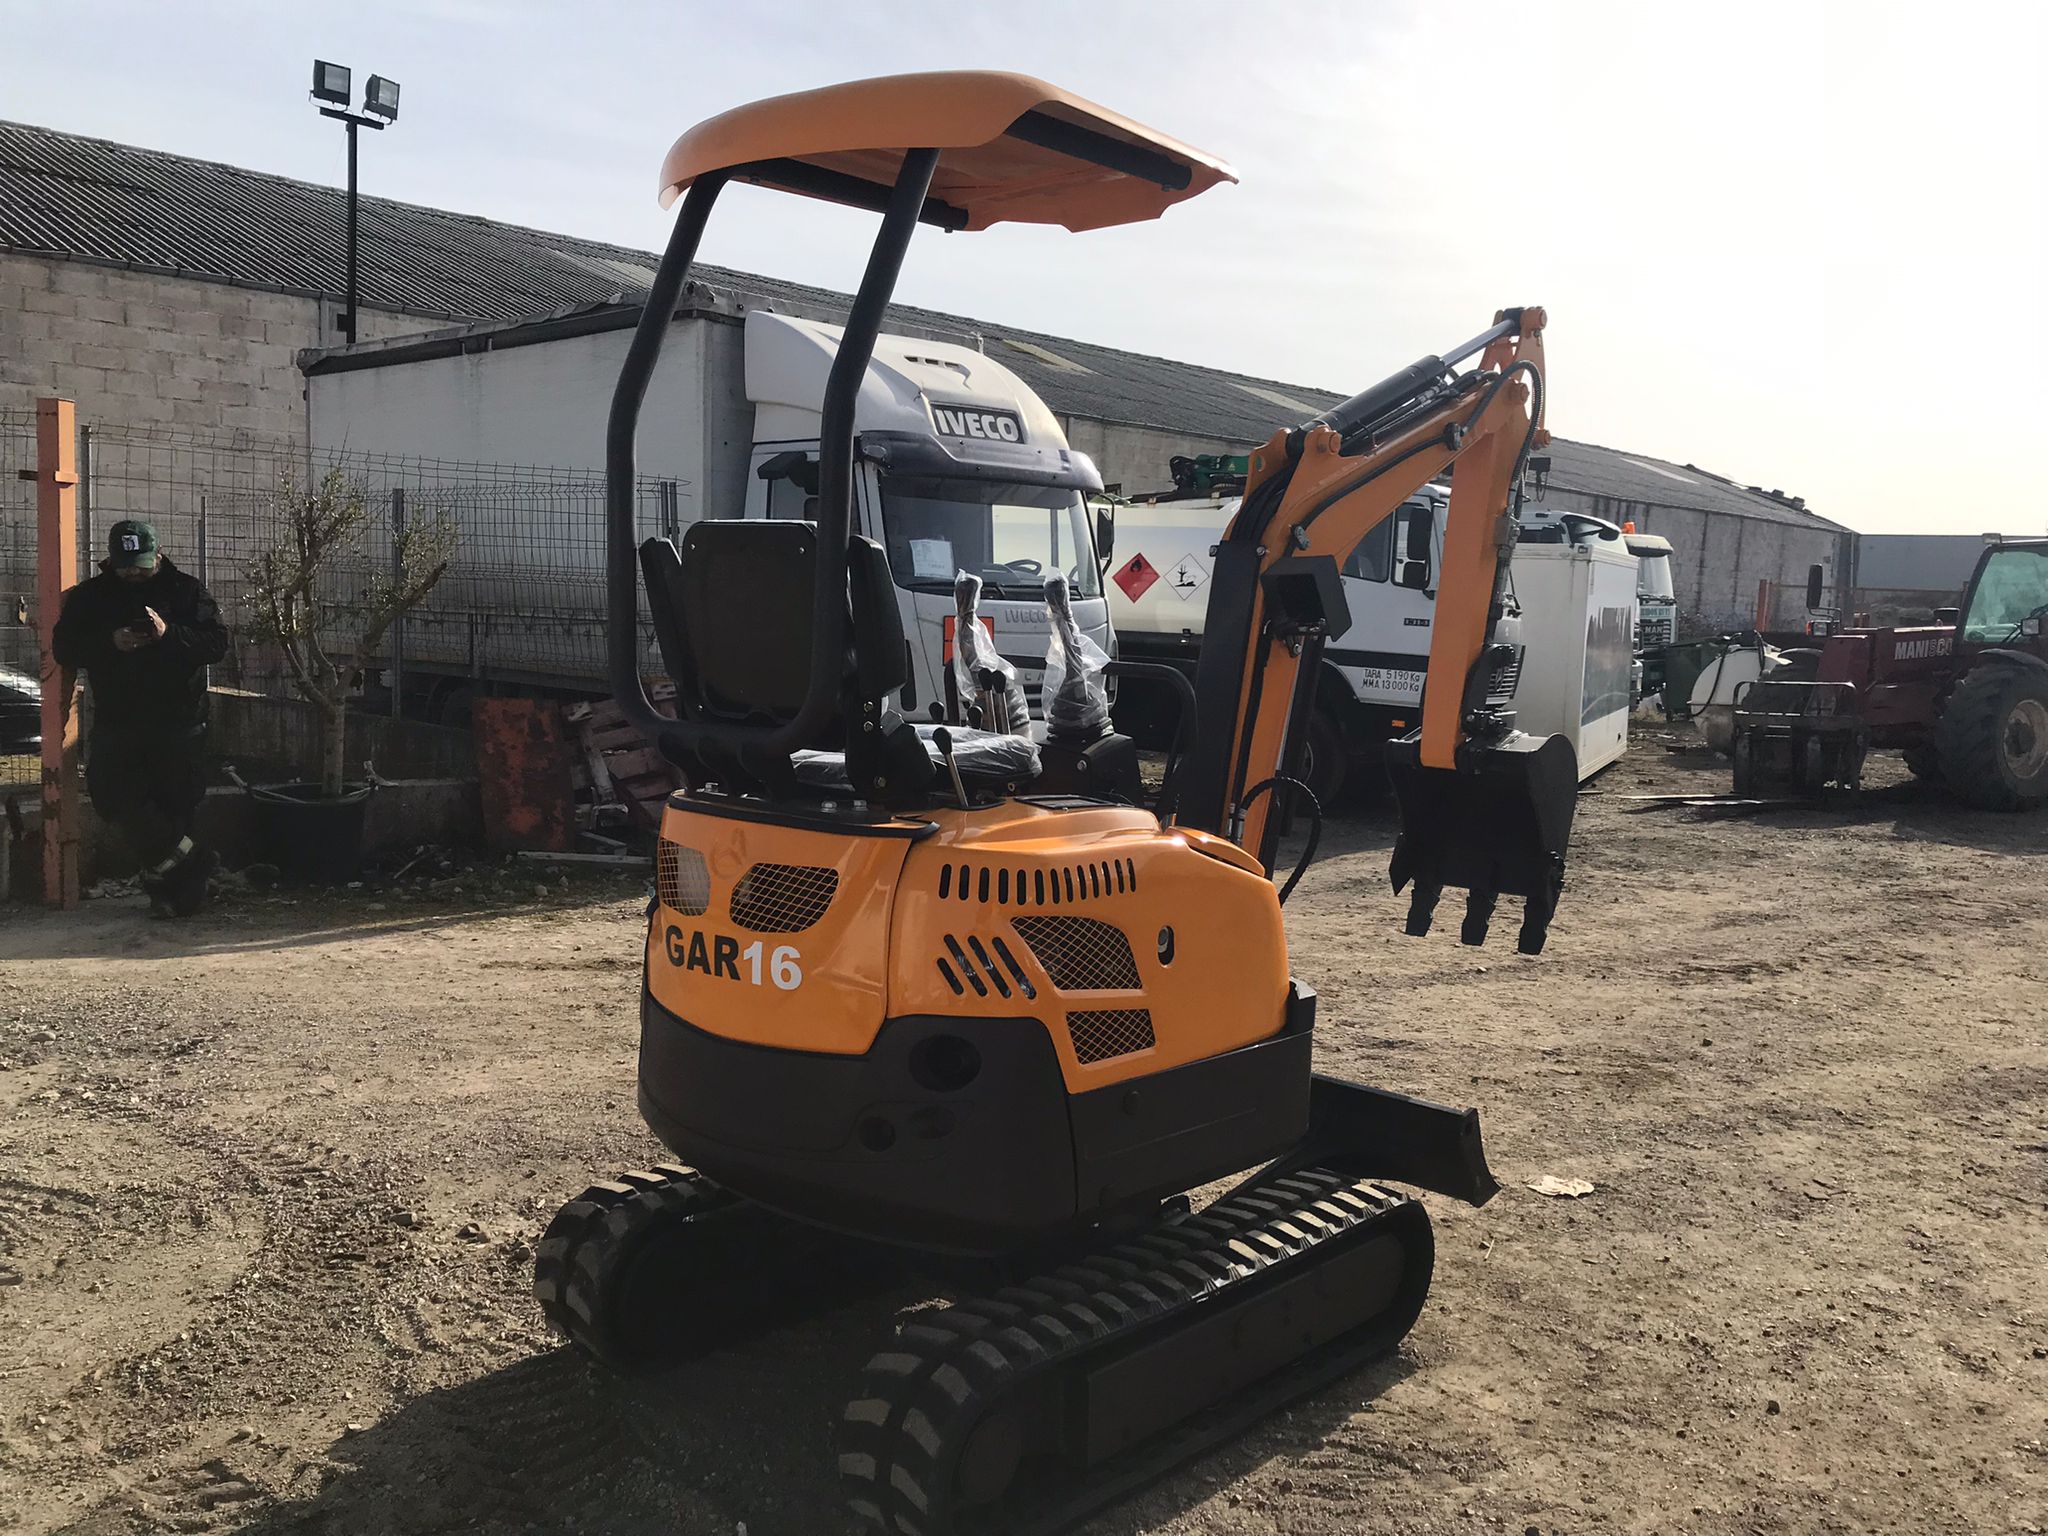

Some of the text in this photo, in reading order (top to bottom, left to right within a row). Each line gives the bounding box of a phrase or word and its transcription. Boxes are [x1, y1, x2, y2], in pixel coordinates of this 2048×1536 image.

[935, 409, 1019, 442] IVECO
[1005, 608, 1047, 624] IVECO
[1364, 669, 1381, 679] TARA
[1362, 678, 1379, 689] MMA
